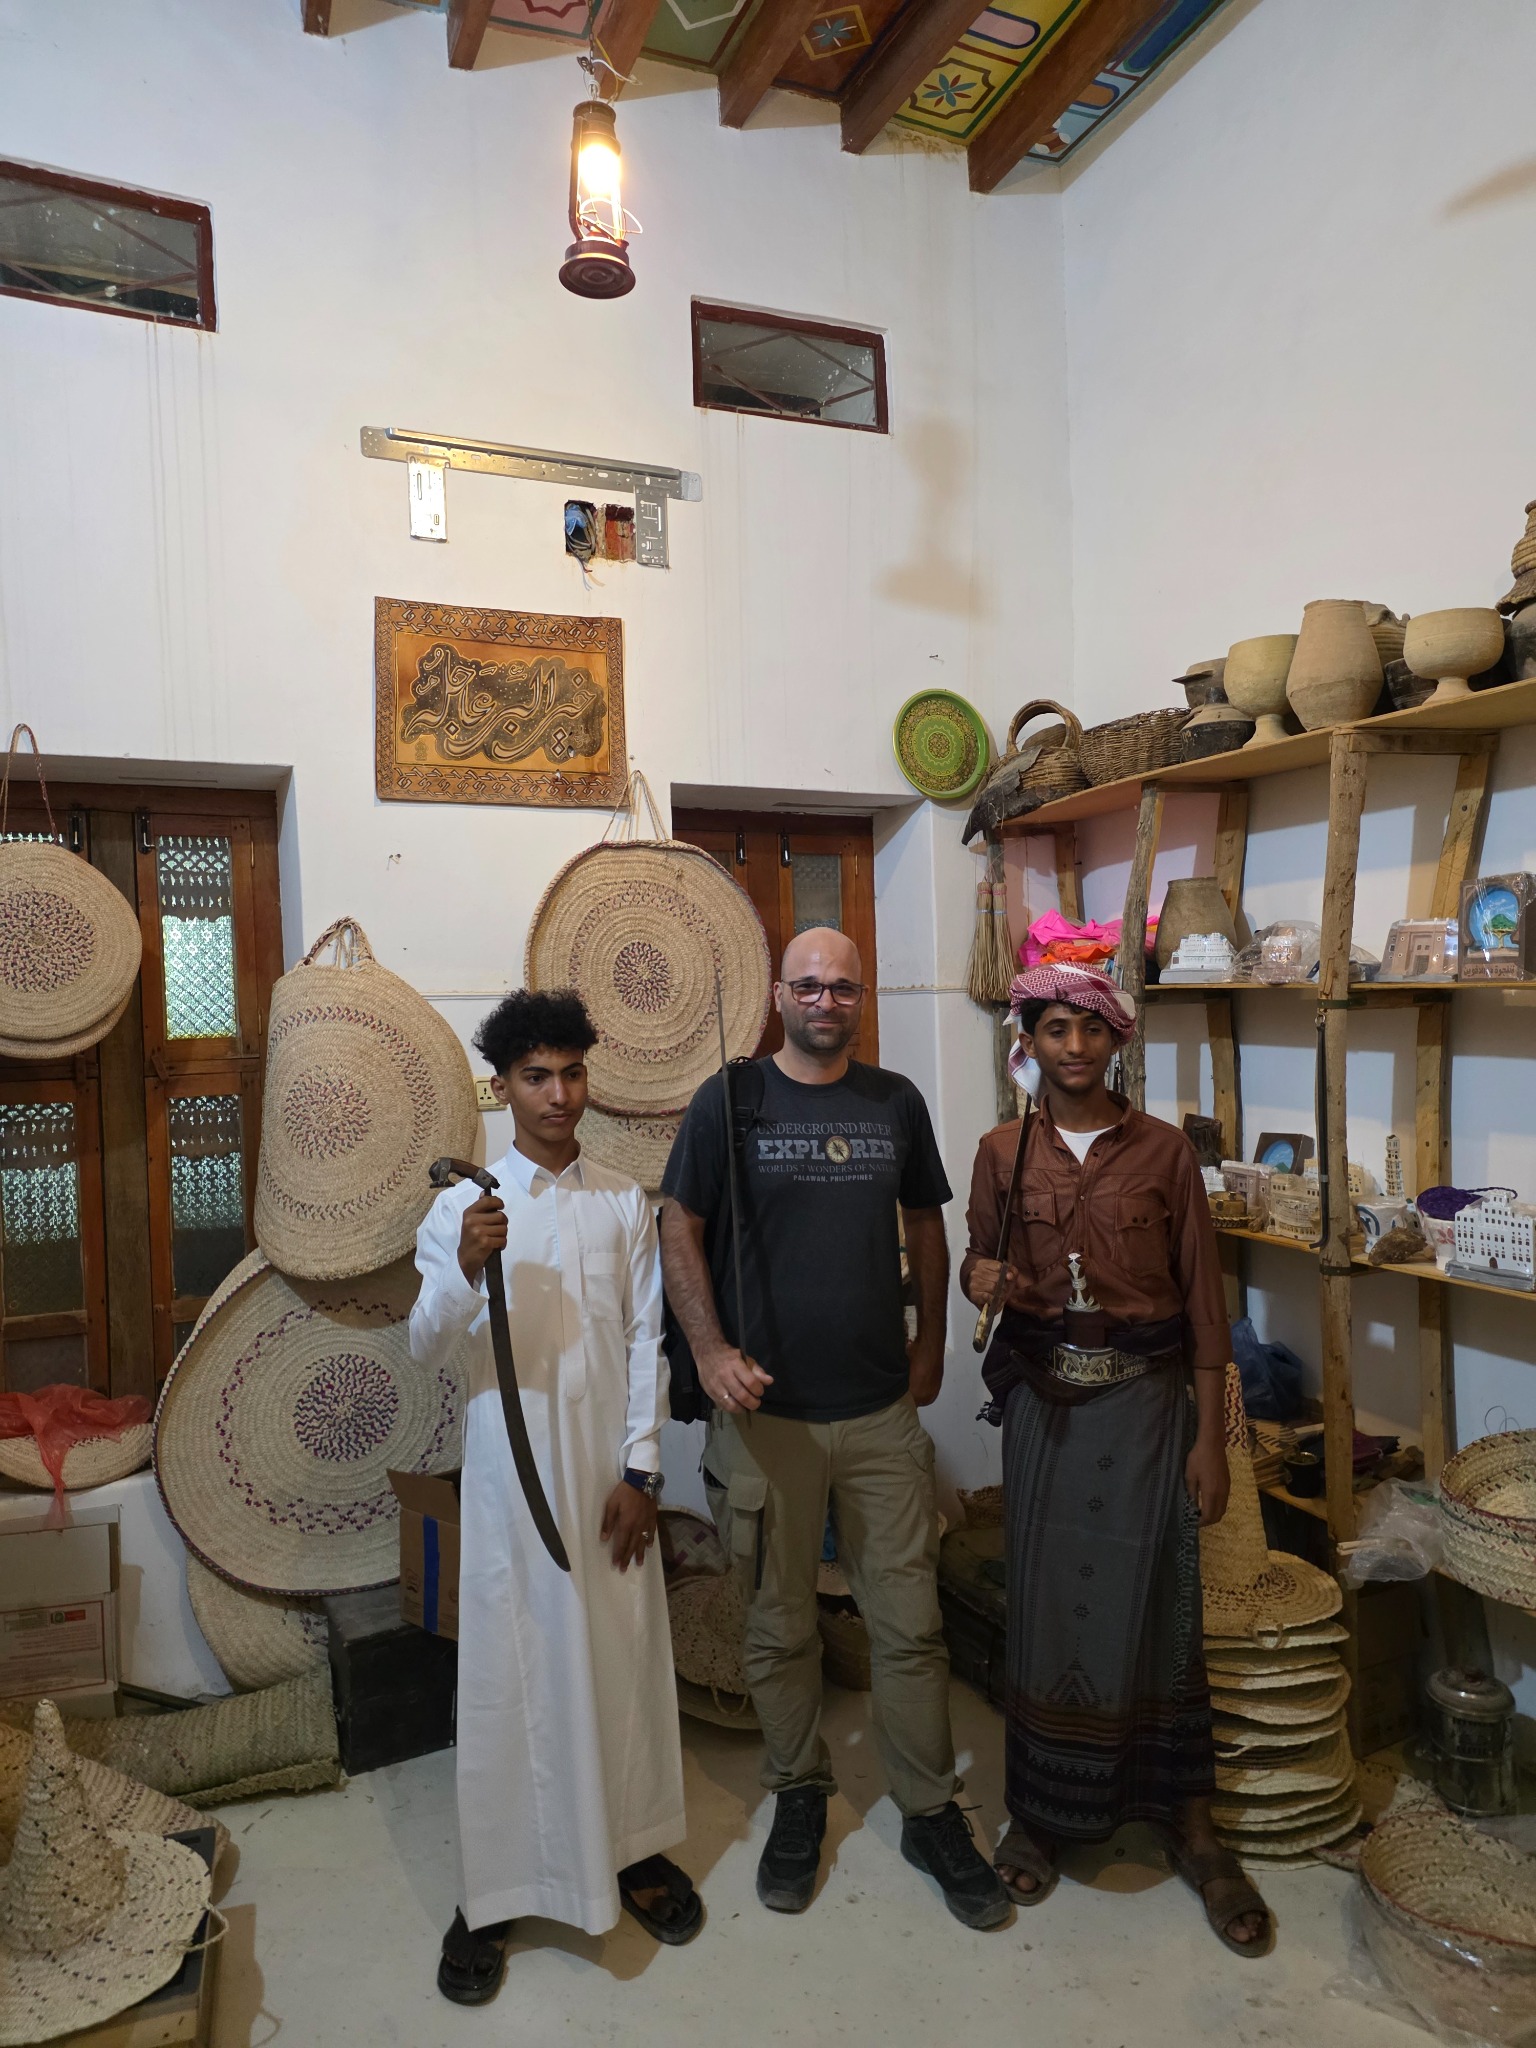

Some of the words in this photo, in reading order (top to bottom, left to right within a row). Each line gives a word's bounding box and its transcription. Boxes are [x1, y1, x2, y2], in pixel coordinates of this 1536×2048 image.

[757, 1122, 857, 1135] UNDERGROUND
[860, 1122, 892, 1136] RIVER
[758, 1164, 798, 1173] WORLDS
[808, 1164, 853, 1173] WONDERS
[854, 1163, 868, 1172] OF
[793, 1174, 828, 1182] PALAWAN,
[830, 1174, 873, 1182] PHILIPPINES
